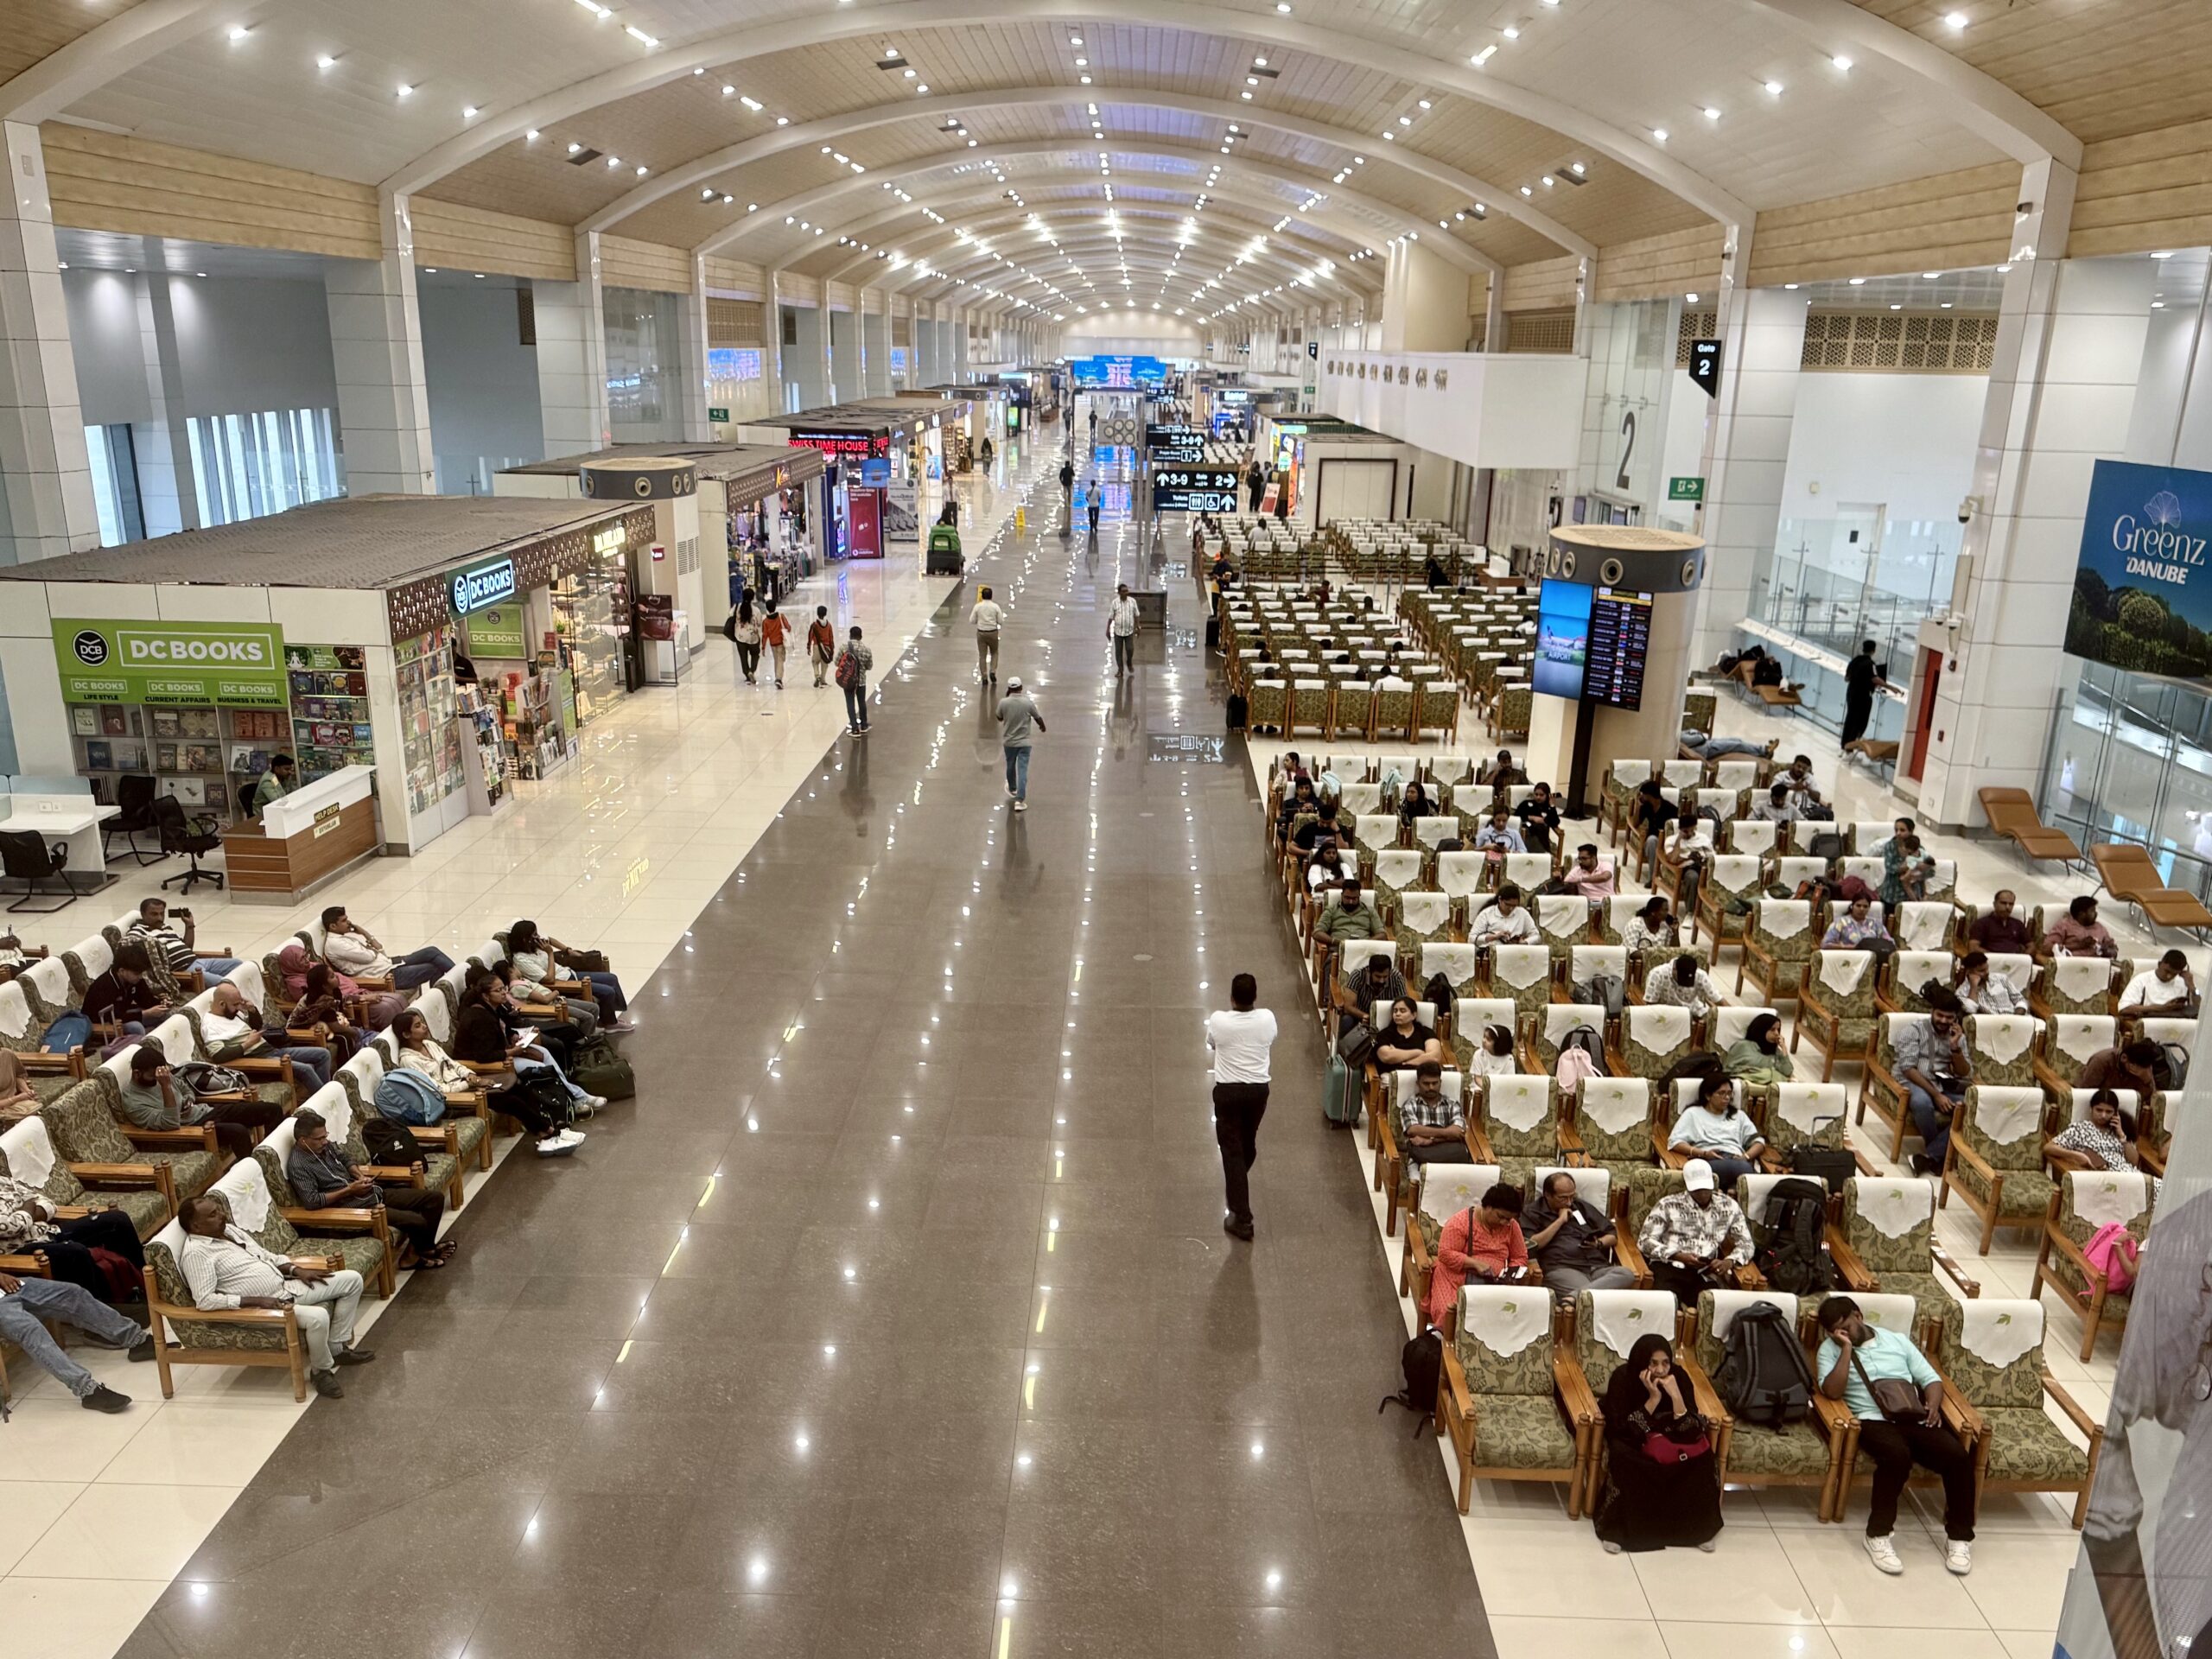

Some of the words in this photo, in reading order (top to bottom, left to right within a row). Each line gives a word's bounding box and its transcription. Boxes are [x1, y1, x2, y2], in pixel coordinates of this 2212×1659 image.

[1697, 344, 1715, 353] Gate
[1699, 359, 1711, 376] 2
[788, 440, 814, 448] SWISS
[816, 441, 836, 450] TIME
[838, 441, 868, 452] HOUSE
[1617, 411, 1636, 490] 2
[1170, 474, 1188, 486] 3-9
[1215, 475, 1224, 486] 2
[2113, 514, 2207, 566] Greenz
[2126, 556, 2189, 585] DANUBE
[470, 579, 483, 600] DC
[482, 569, 512, 594] BOOKS
[487, 634, 520, 643] BOOKS
[79, 645, 102, 656] DCB
[130, 639, 168, 659] DC
[170, 641, 263, 661] BOOKS
[74, 681, 88, 690] DC
[90, 681, 125, 691] BOOKS
[150, 683, 164, 692] DC
[167, 683, 201, 693] BOOKS
[223, 685, 237, 694] DC
[238, 685, 274, 695] BOOKS
[315, 810, 327, 821] HELP
[327, 804, 339, 816] DESK
